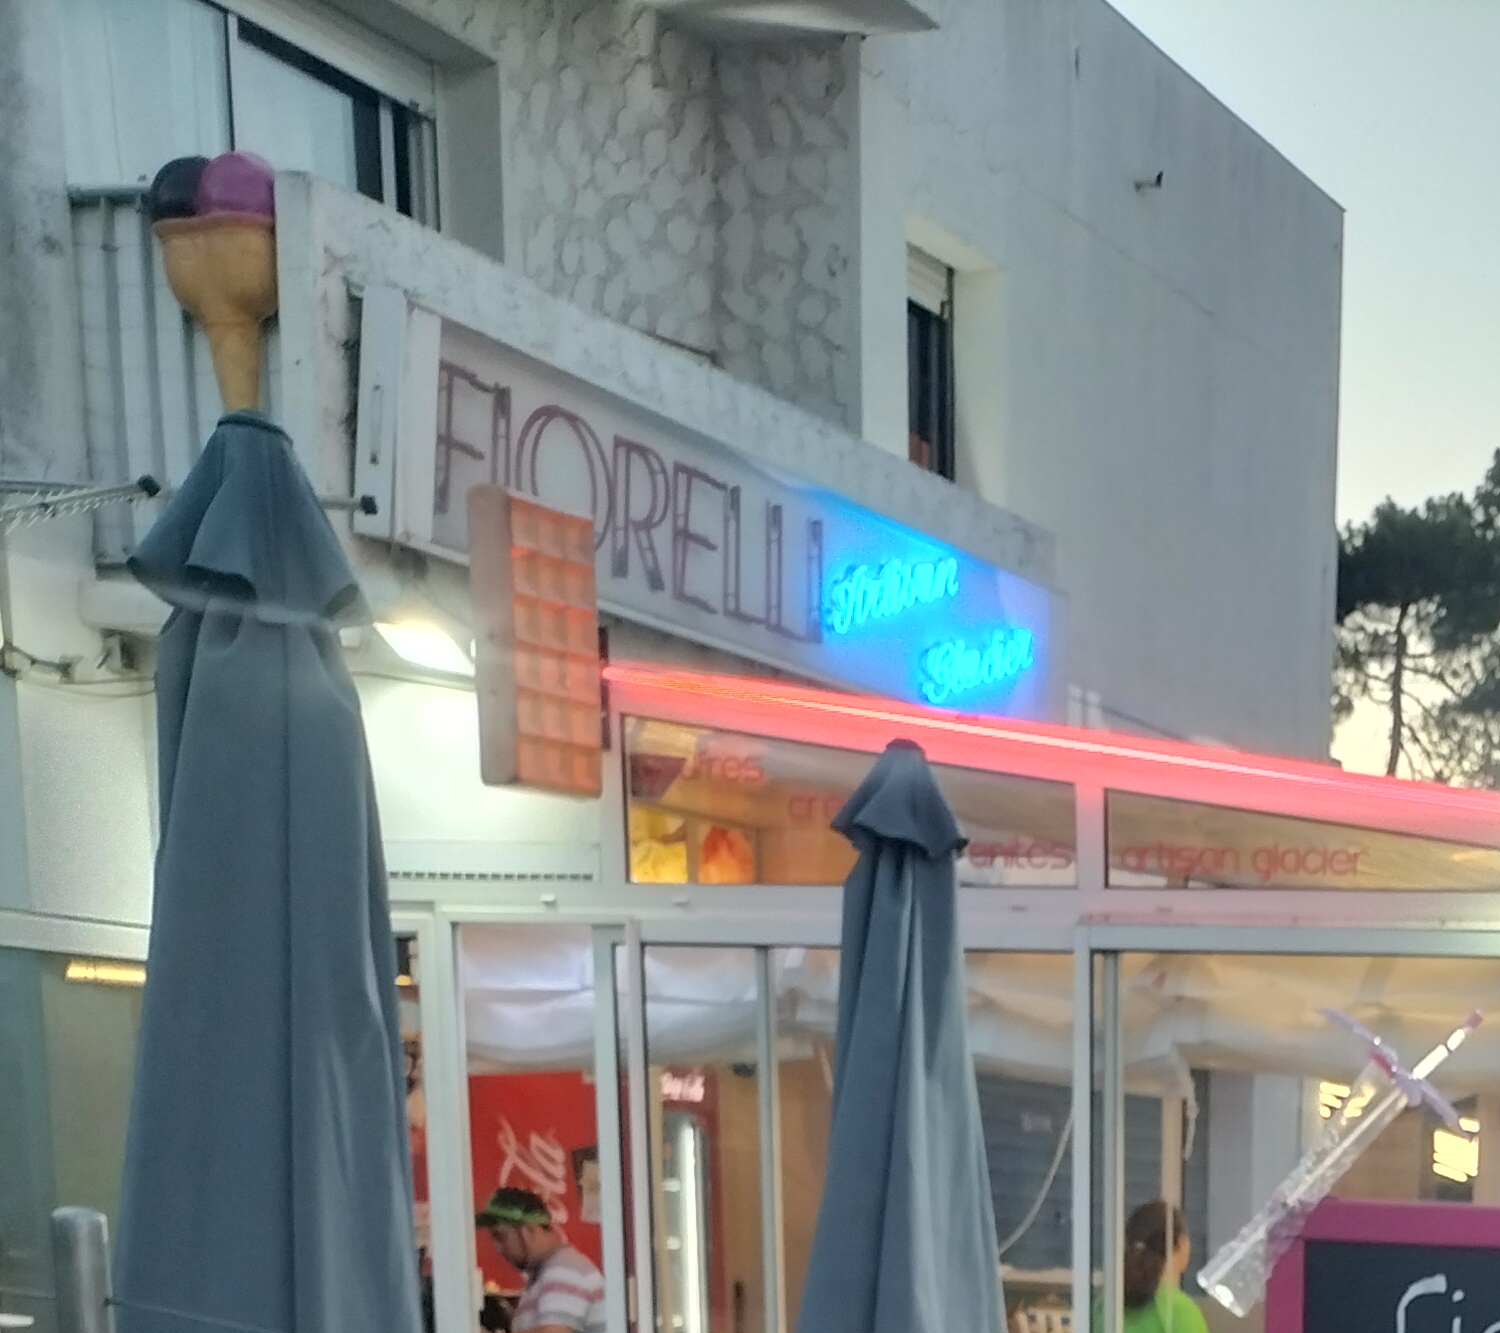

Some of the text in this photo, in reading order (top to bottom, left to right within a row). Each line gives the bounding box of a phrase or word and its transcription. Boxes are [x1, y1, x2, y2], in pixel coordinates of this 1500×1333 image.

[434, 360, 823, 644] FIORELLI
[1121, 843, 1369, 882] artisan glacier
